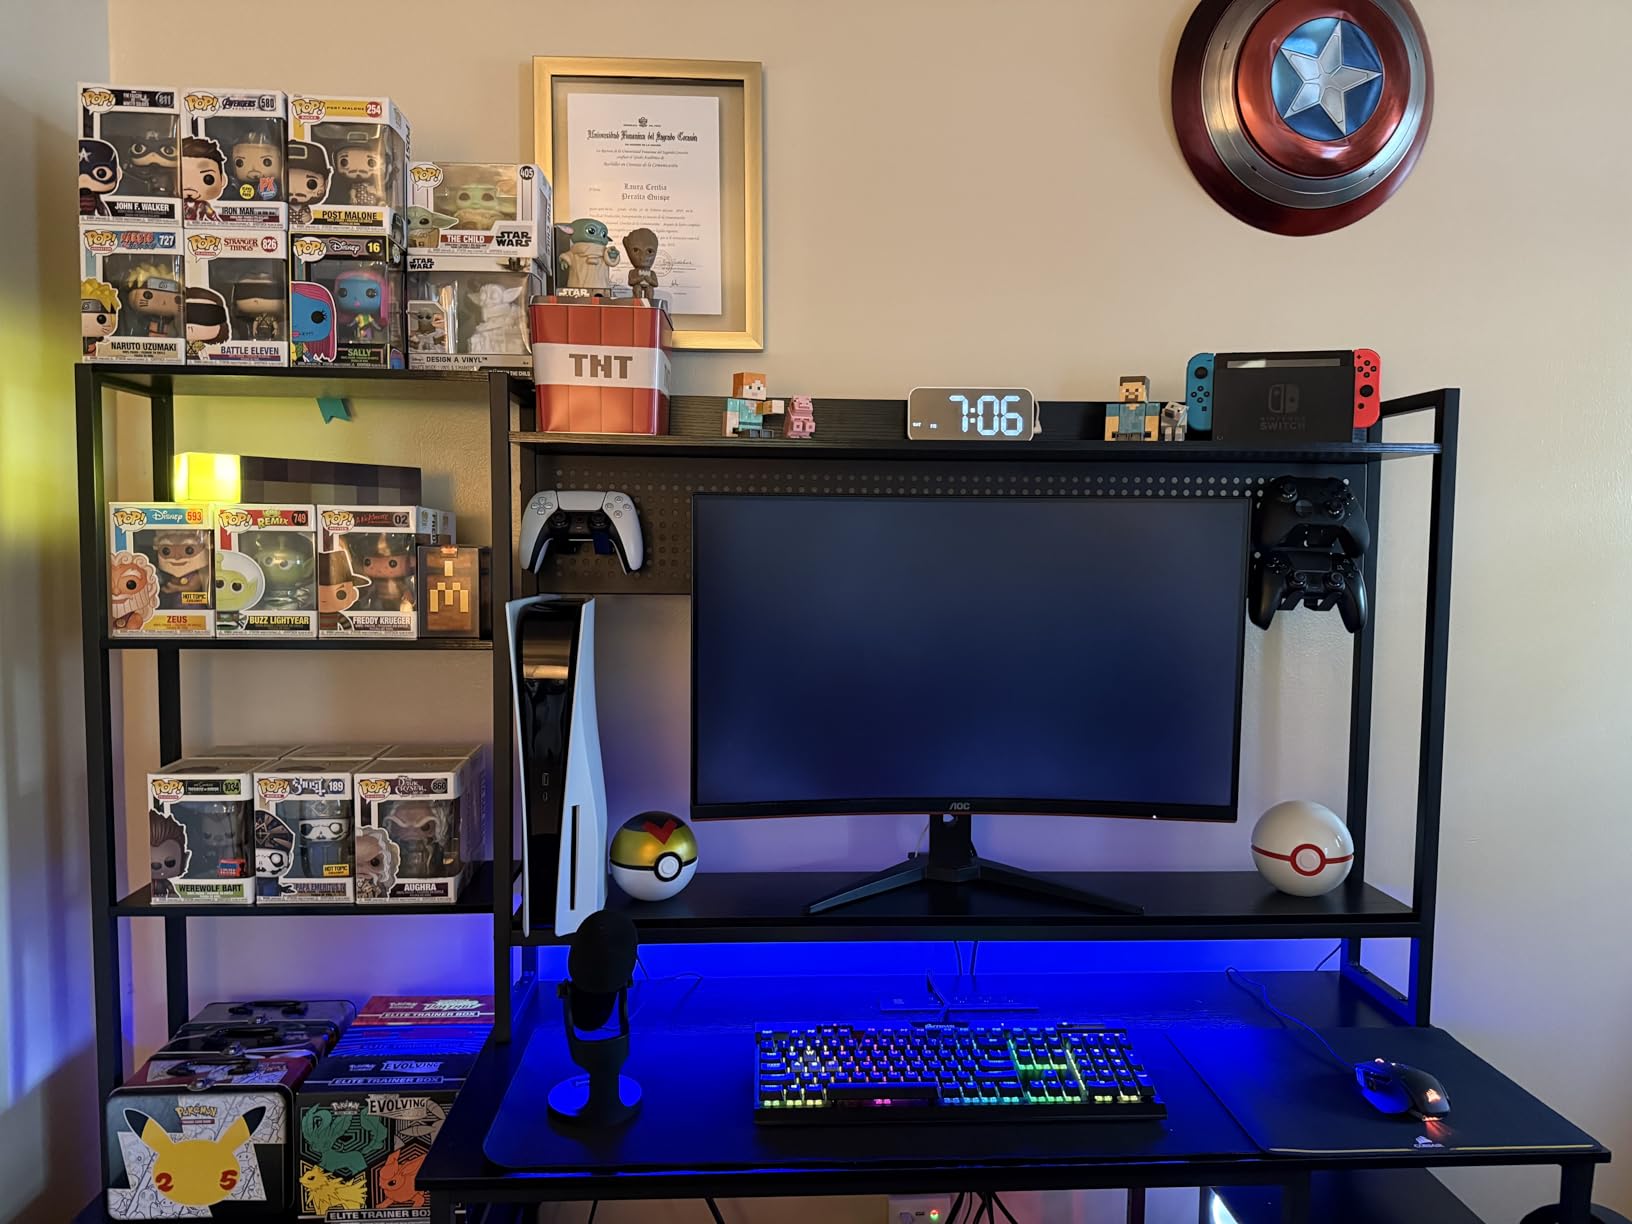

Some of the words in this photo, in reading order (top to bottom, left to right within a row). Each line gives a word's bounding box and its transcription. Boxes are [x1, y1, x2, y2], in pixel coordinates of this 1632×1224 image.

[82, 90, 113, 107] POP!
[184, 94, 218, 111] POP!
[222, 97, 256, 110] AVENGERS
[261, 98, 274, 108] 580
[292, 99, 326, 115] POP!
[367, 104, 381, 114] 254
[410, 167, 440, 182] POP!
[142, 203, 169, 212] WALKER
[222, 207, 238, 215] IRON
[322, 211, 342, 219] POST
[345, 211, 377, 220] MALONE
[84, 230, 116, 248] POP!
[159, 235, 174, 245] 727
[496, 231, 531, 239] STAR
[188, 235, 221, 251] POP!
[224, 238, 258, 246] STRANGER
[262, 239, 276, 249] 826
[295, 240, 325, 256] POP!
[329, 239, 360, 254] Disney
[368, 242, 380, 252] 16
[111, 342, 140, 350] NARUTO
[142, 343, 176, 351] UZUMAKI
[569, 354, 633, 379] TNT
[948, 395, 1023, 436] 7:06
[1259, 422, 1306, 430] SWITCH
[113, 511, 146, 525] POP!
[150, 509, 182, 523] Disney
[187, 512, 202, 521] 593
[219, 512, 252, 527] POP!
[257, 516, 288, 529] REMIX
[294, 514, 306, 523] 749
[321, 512, 353, 526] POP!
[395, 515, 408, 524] 02
[151, 780, 183, 794] POP!
[257, 780, 288, 793] POP!
[329, 782, 343, 792] 189
[358, 780, 389, 794] POP!
[370, 1099, 425, 1113] EVOLVING
[155, 1172, 174, 1192] 2
[220, 1170, 238, 1190] 5
